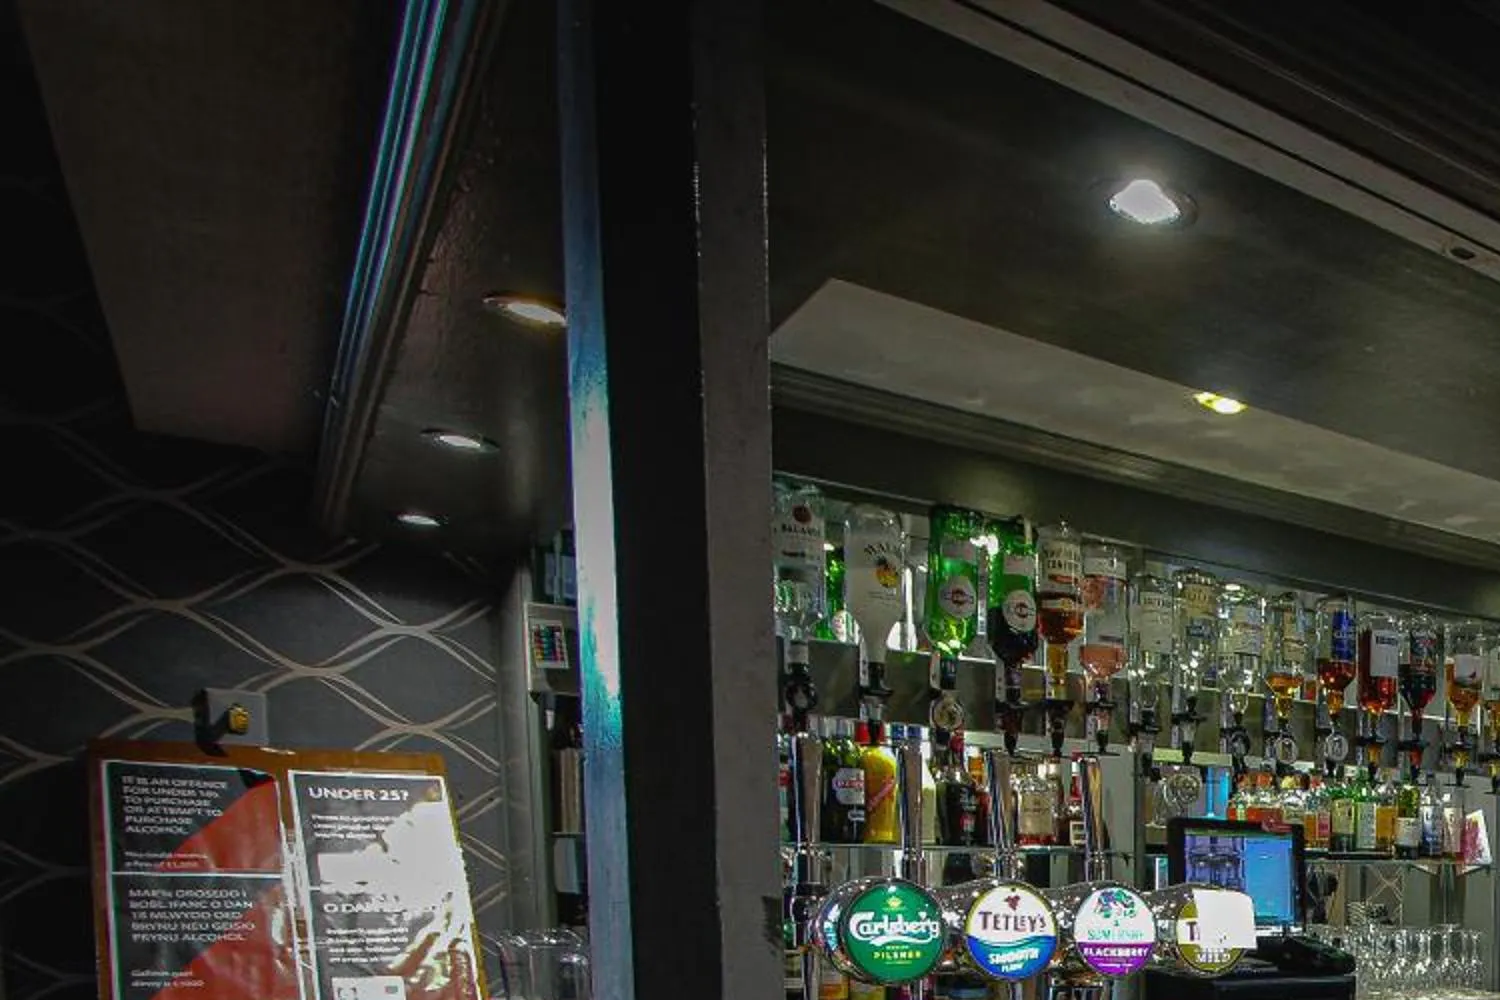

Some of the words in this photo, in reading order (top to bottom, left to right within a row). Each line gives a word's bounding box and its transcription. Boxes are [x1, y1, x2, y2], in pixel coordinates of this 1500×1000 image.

[122, 786, 150, 794] FOR
[152, 787, 197, 797] UNDER
[308, 787, 377, 800] UNDER
[379, 789, 408, 801] 25?
[122, 795, 142, 804] TO
[144, 796, 211, 806] PURCHASE
[123, 805, 144, 814] OR
[147, 806, 203, 816] ATTEMPT
[206, 809, 223, 817] TO
[125, 815, 193, 824] PURCHASE
[223, 901, 253, 909] DAN
[181, 922, 209, 931] NEU
[978, 911, 1046, 932] TETLEY'S
[849, 911, 941, 946] Carlsberg
[873, 951, 921, 959] PILSNER
[1083, 947, 1149, 957] BLACKBERRY
